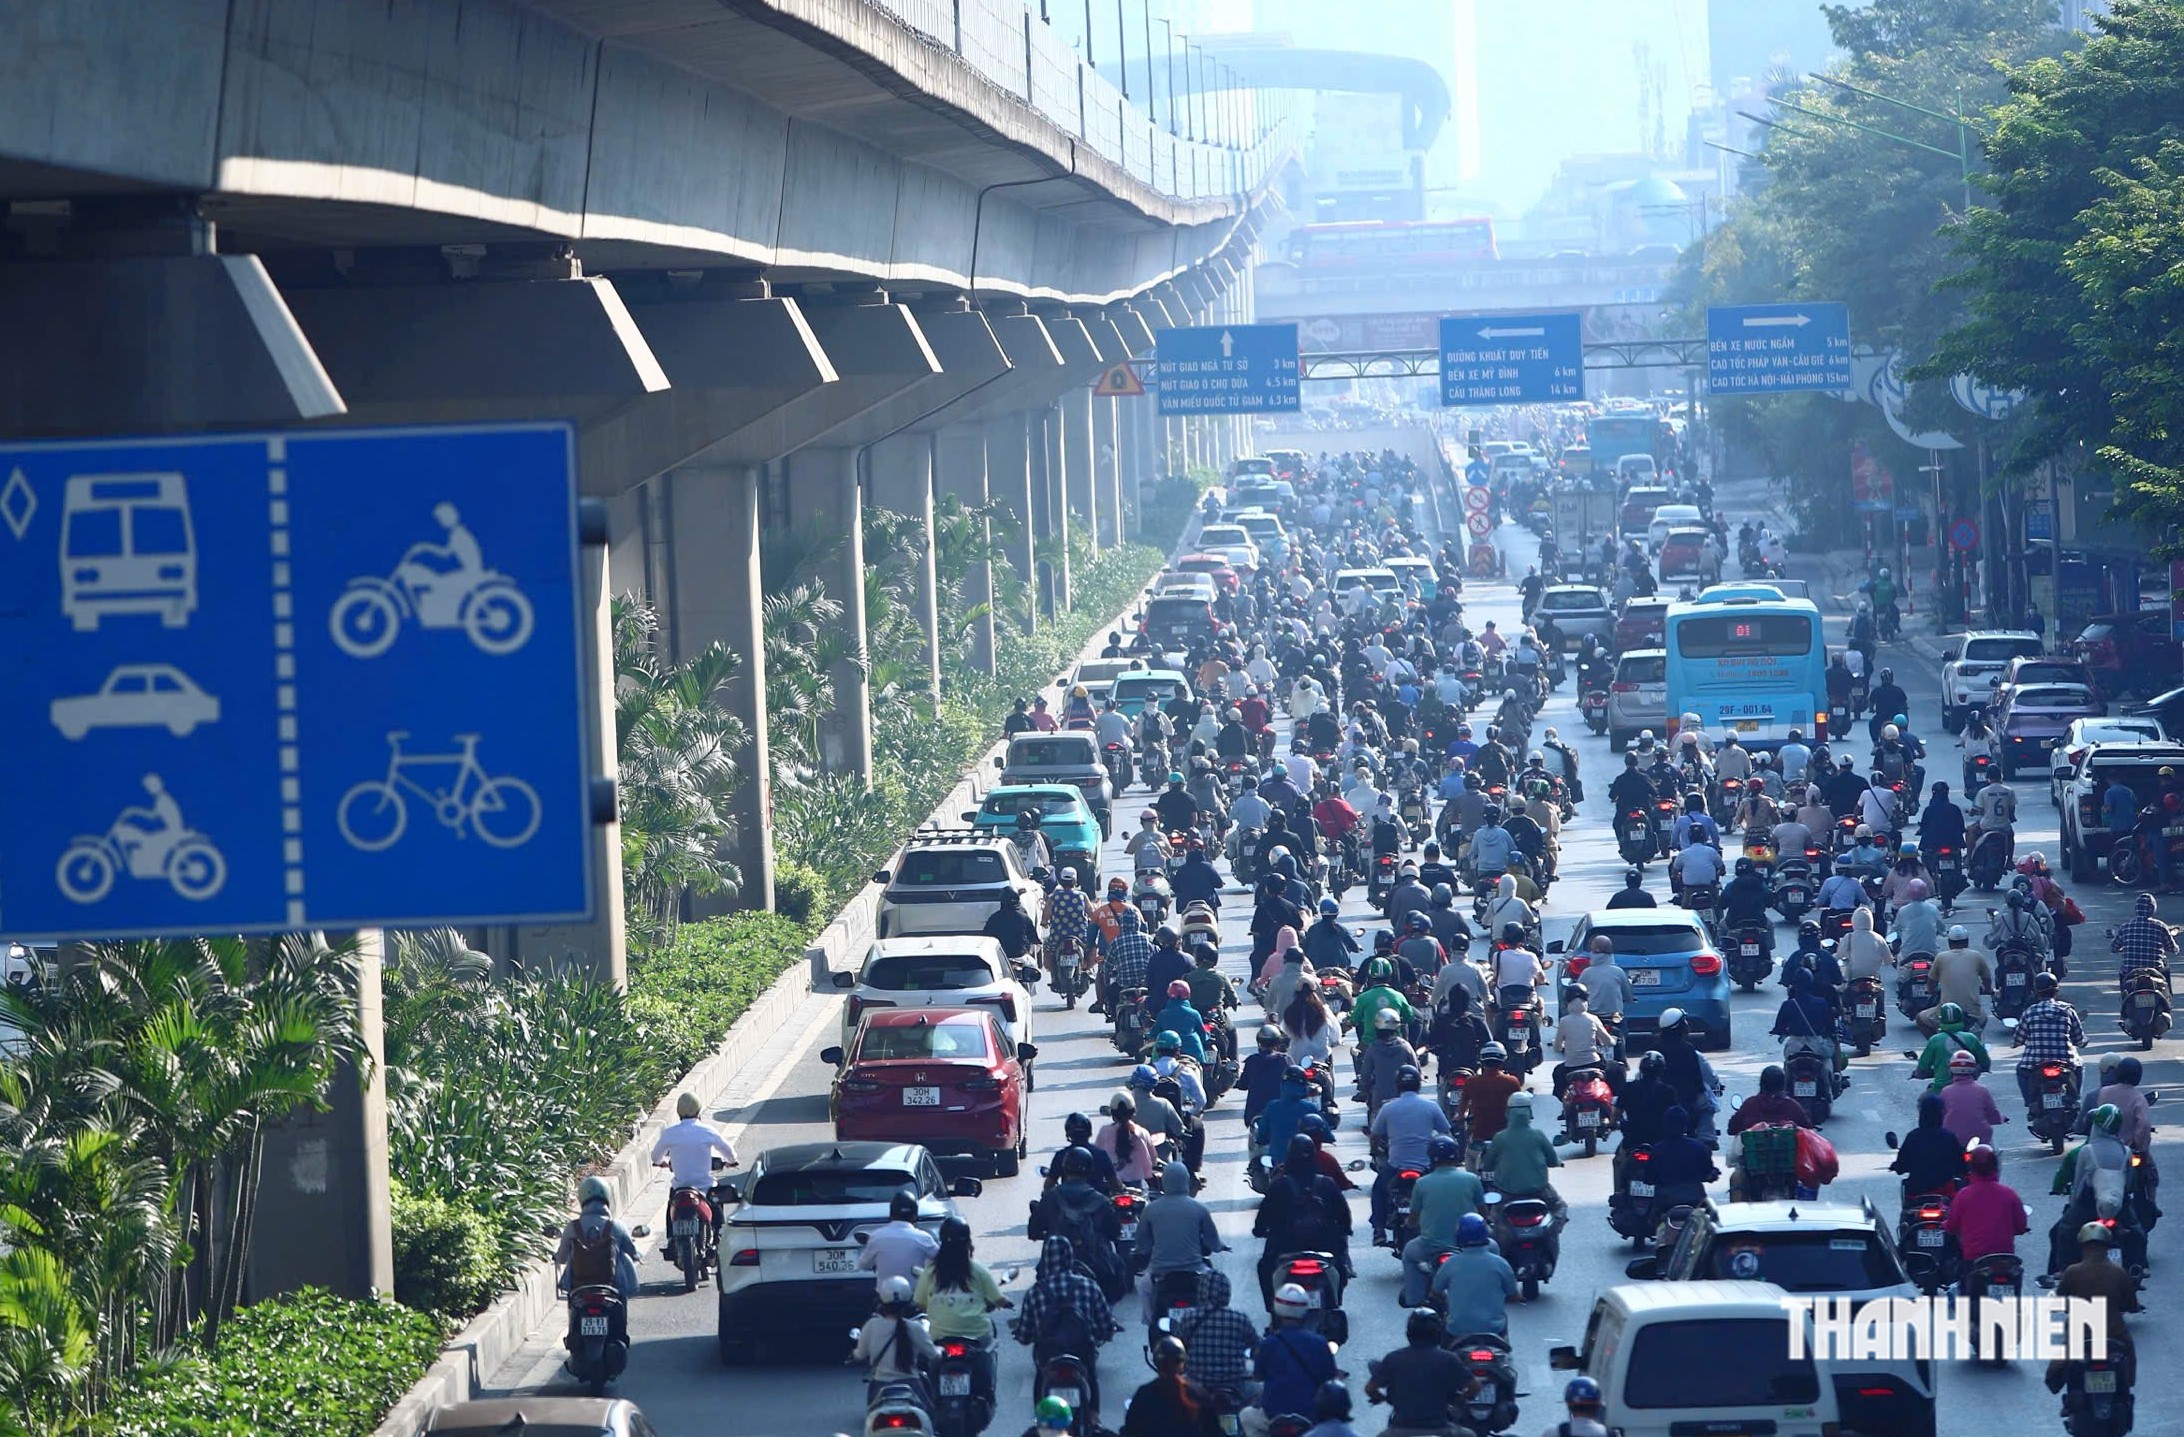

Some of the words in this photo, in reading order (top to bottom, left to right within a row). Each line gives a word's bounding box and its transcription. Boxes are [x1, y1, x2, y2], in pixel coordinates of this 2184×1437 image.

[1730, 340, 1741, 351] XE
[1826, 337, 1832, 347] 5
[1834, 337, 1848, 347] km
[1180, 361, 1198, 371] GIAO
[1274, 359, 1279, 369] 3
[1282, 359, 1296, 369] km
[1711, 359, 1728, 370] CAO
[1828, 355, 1834, 365] 6
[1835, 355, 1848, 365] km
[1468, 369, 1479, 380] XE
[1554, 367, 1560, 377] 6
[1562, 366, 1576, 377] km
[1180, 379, 1199, 390] GIAO
[1283, 377, 1296, 387] km
[1712, 377, 1729, 388] CAO
[1826, 373, 1835, 384] 15
[1835, 373, 1849, 384] km
[1499, 386, 1521, 397] LONG
[1550, 384, 1560, 395] 14
[1563, 384, 1577, 395] km
[1283, 395, 1297, 405] km
[1994, 798, 2004, 816] 6
[913, 1088, 930, 1096] 30H
[907, 1096, 936, 1105] 342.26
[828, 1250, 846, 1260] 30M
